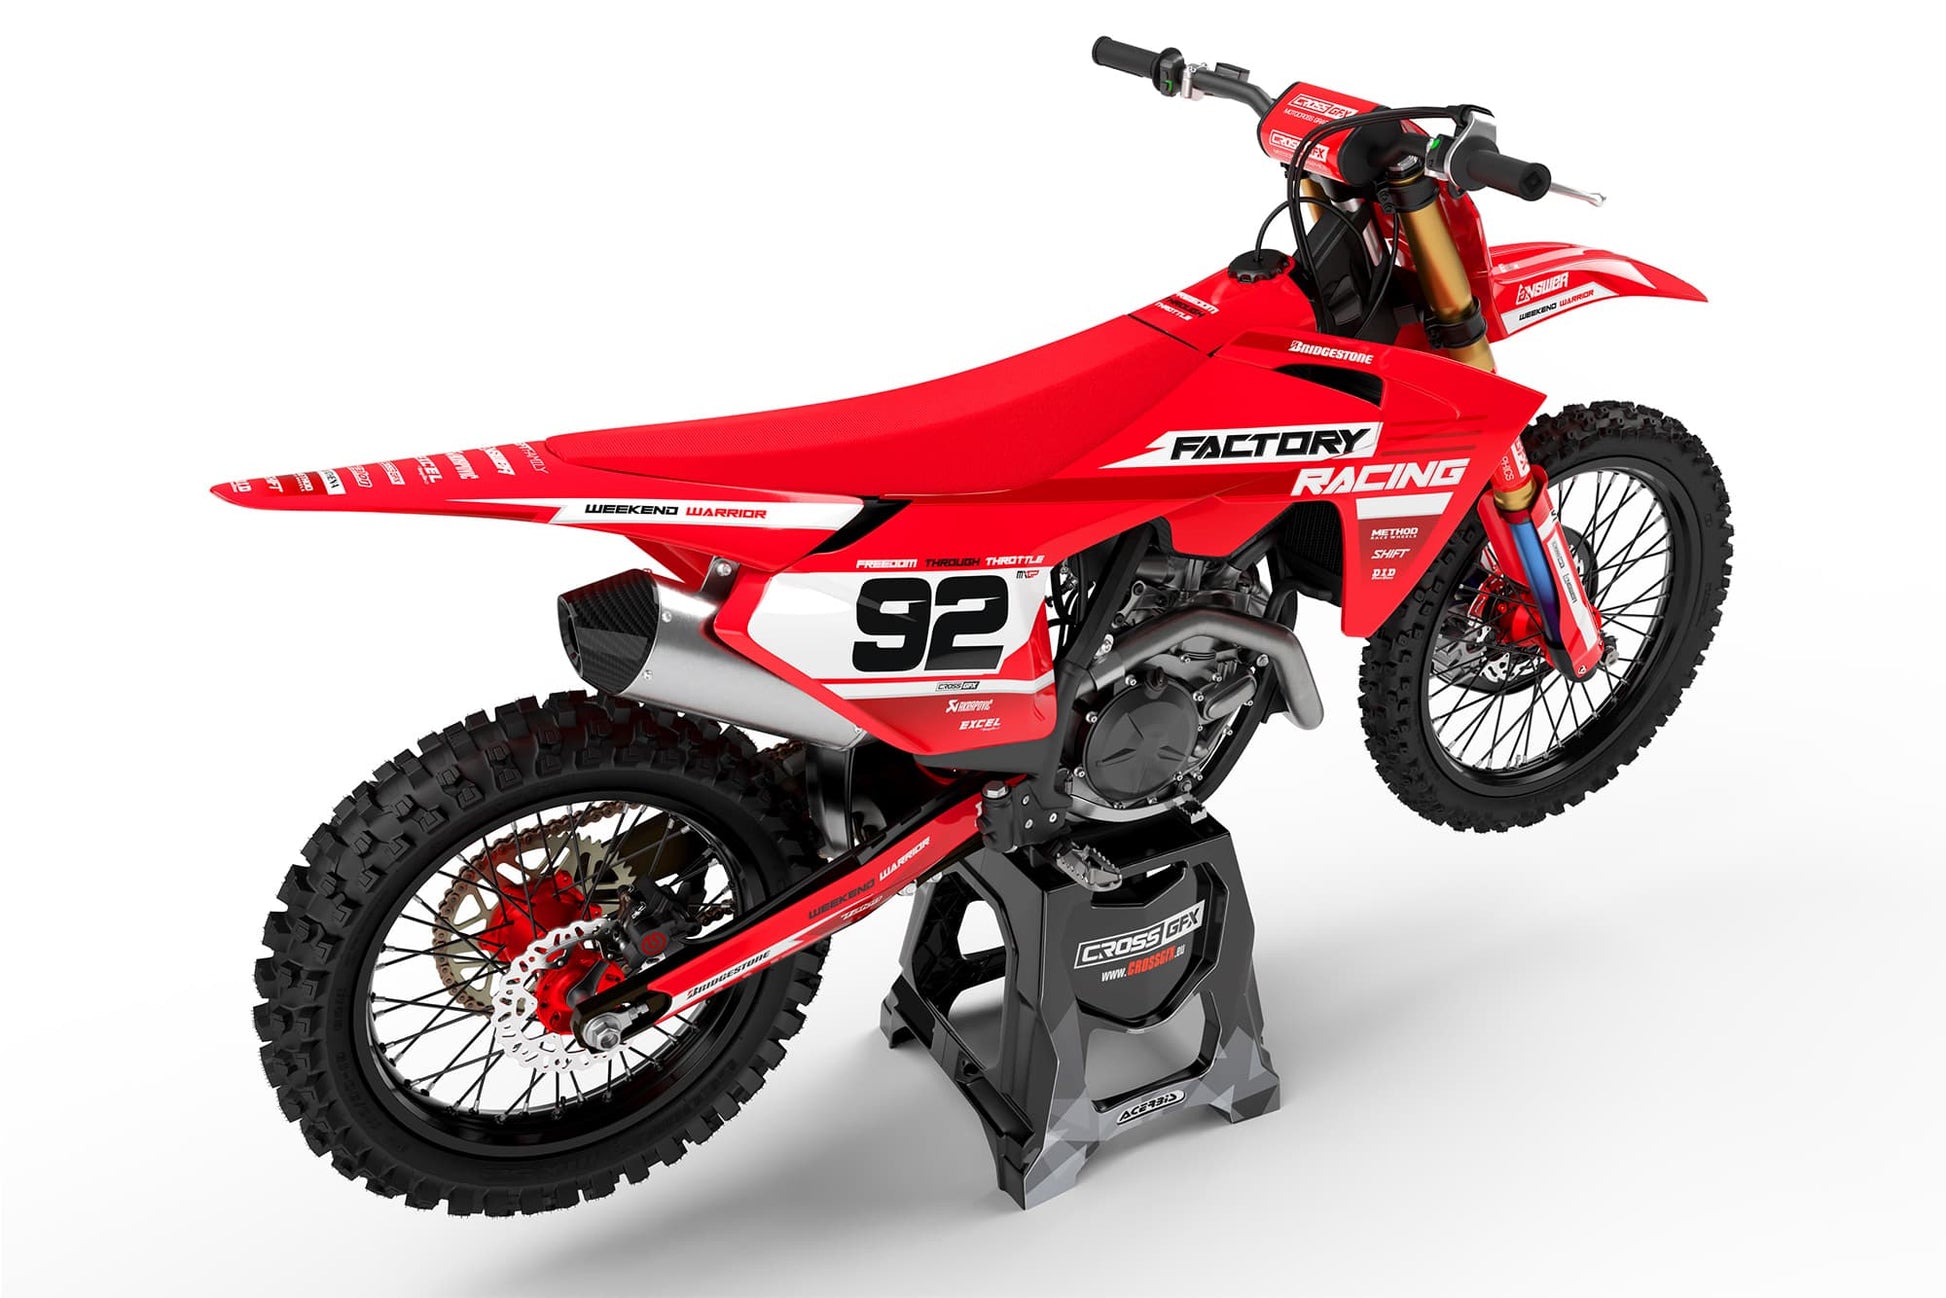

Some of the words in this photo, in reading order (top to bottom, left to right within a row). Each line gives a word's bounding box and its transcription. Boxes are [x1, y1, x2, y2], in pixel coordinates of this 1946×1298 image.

[1293, 96, 1331, 114] CROSS
[1518, 302, 1557, 321] WEEKEND
[1559, 289, 1594, 307] WARRIOR
[1288, 340, 1374, 364] BRIDGESTONE
[1170, 428, 1371, 460] FACTORY
[1290, 458, 1470, 496] RACING
[584, 504, 679, 516] WEEKEND
[685, 506, 767, 519] WARRIOR
[1371, 527, 1419, 536] METHOD
[856, 558, 918, 568] FREEDOM
[925, 557, 981, 567] THROUGH
[985, 555, 1045, 565] THROTTLE
[1371, 548, 1411, 559] SHIFT
[852, 575, 1009, 672] 92
[959, 717, 1001, 730] EXCEL
[808, 878, 875, 920] WEEKEND
[879, 836, 931, 882] WARRIOR
[1081, 929, 1161, 963] CROSS
[1165, 908, 1200, 938] GFX
[686, 949, 771, 999] BRIDGESTONE
